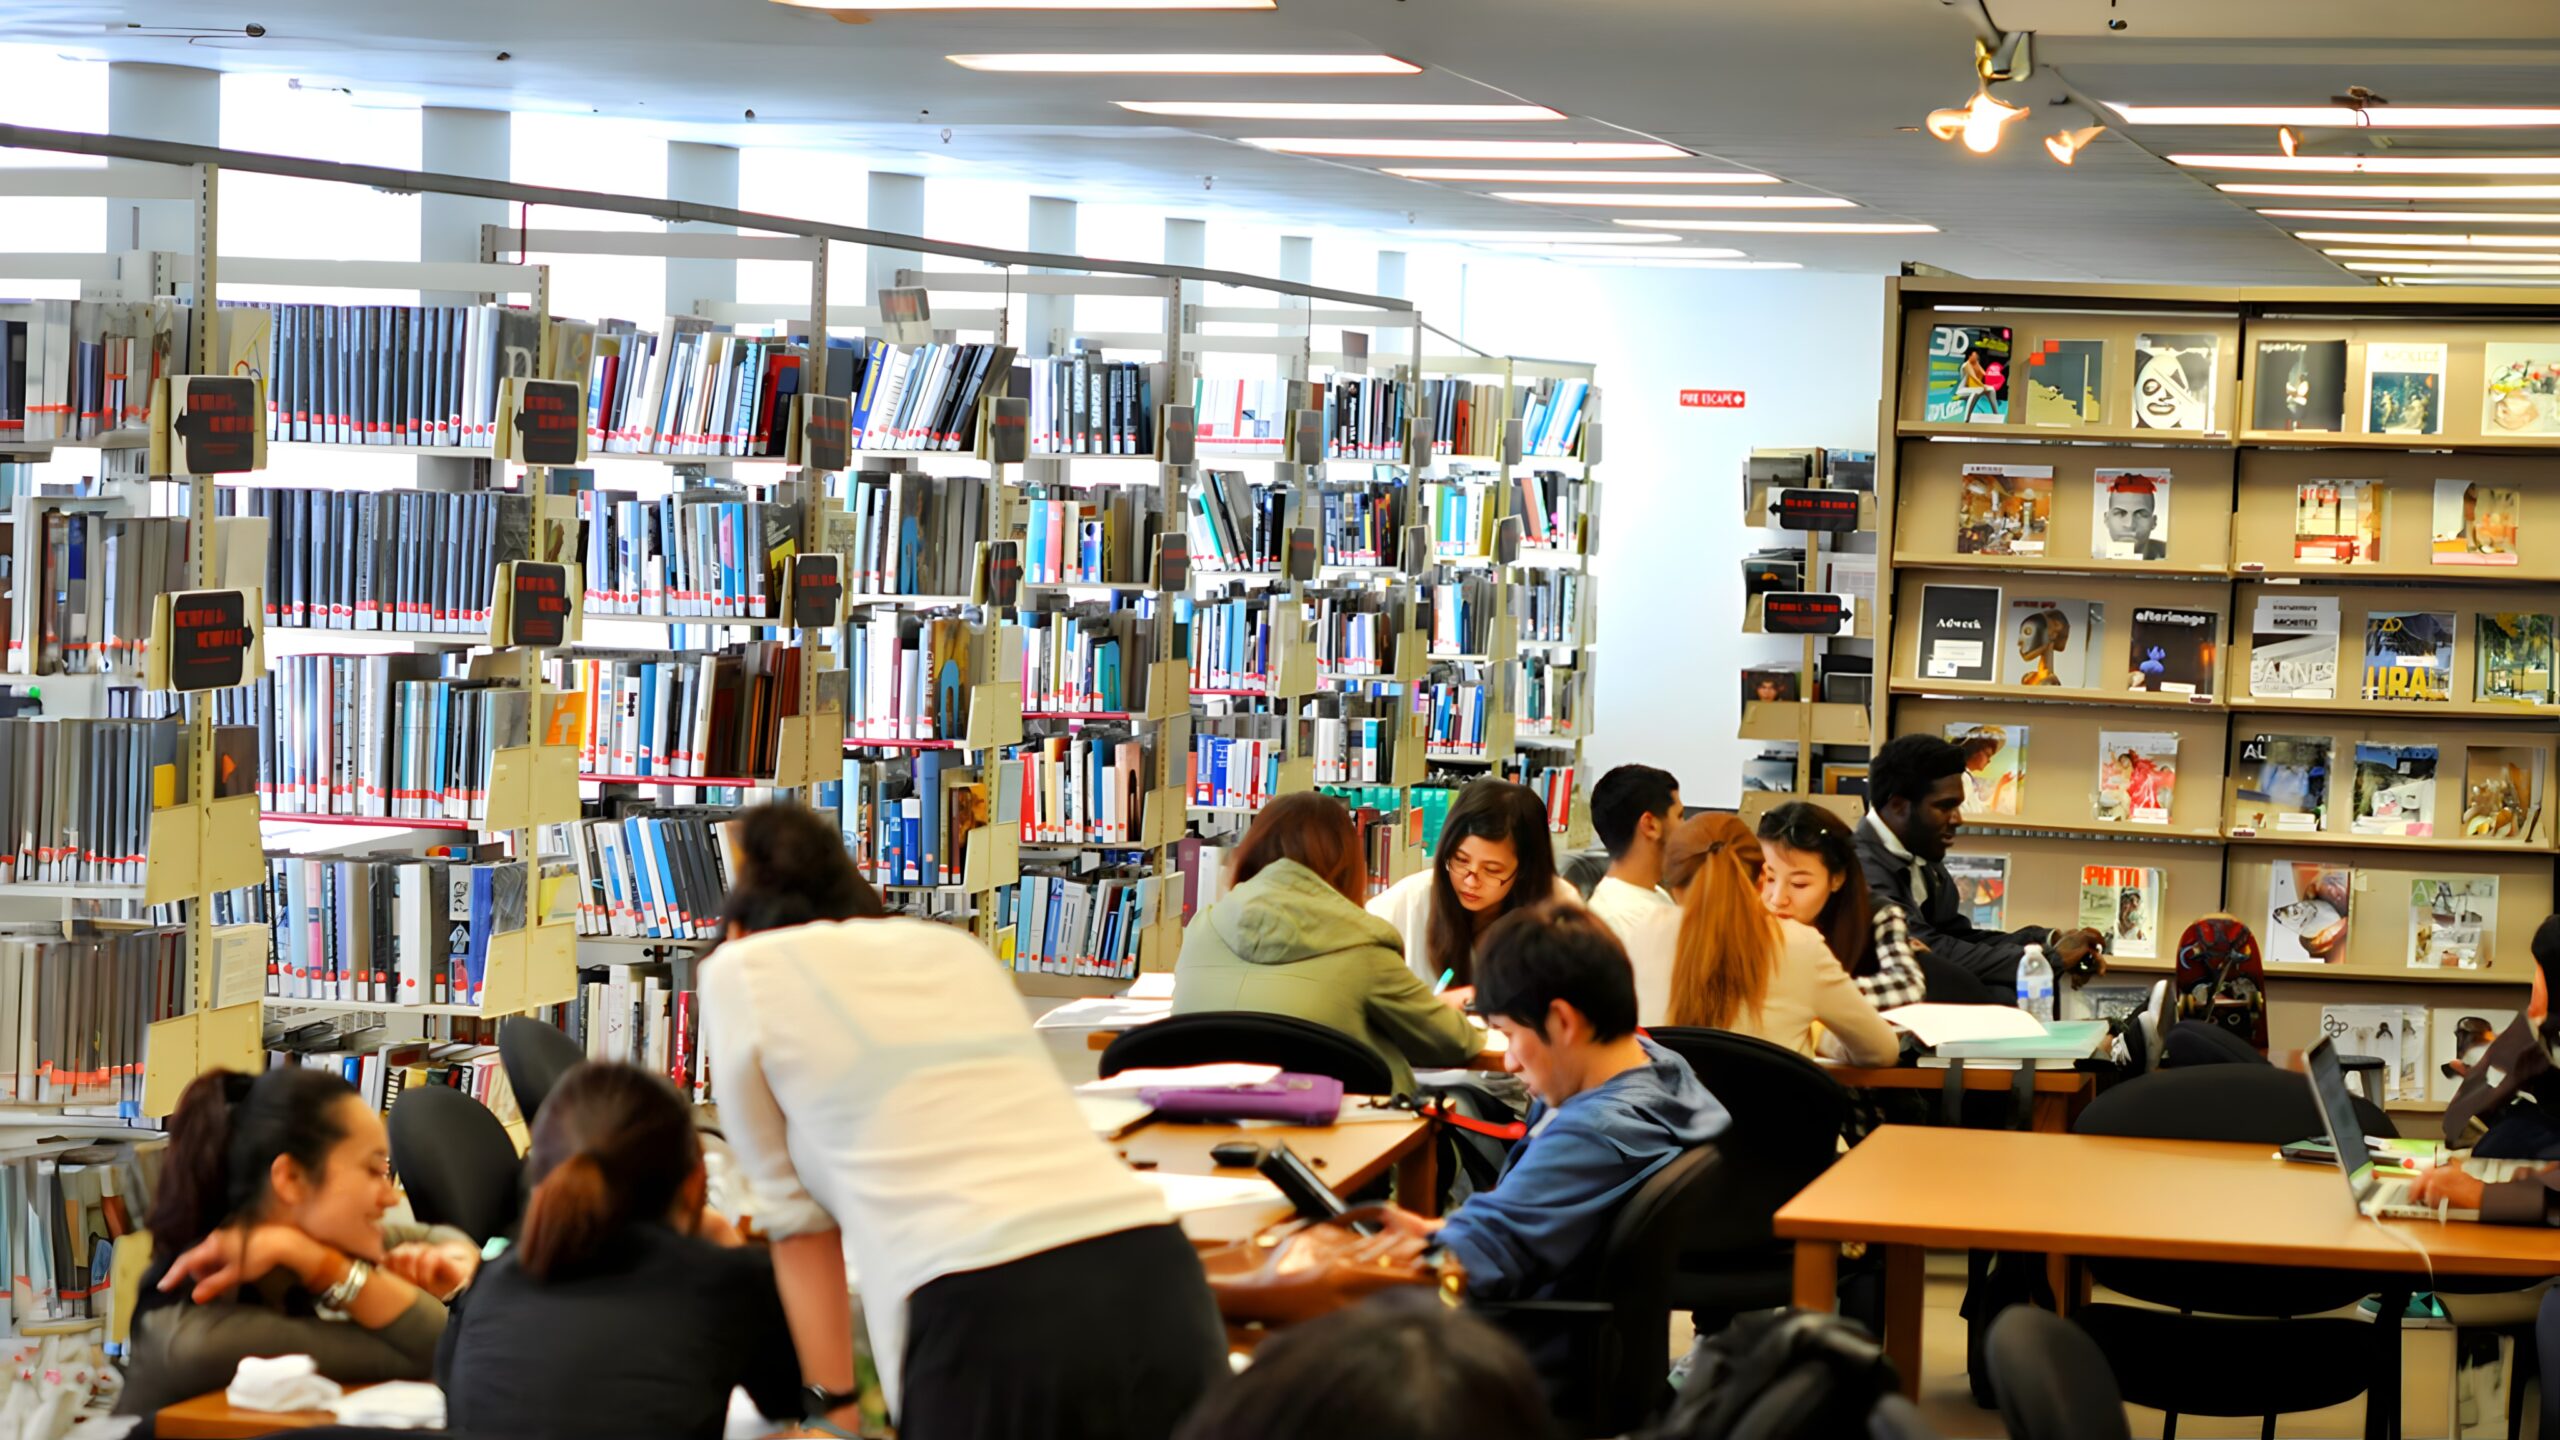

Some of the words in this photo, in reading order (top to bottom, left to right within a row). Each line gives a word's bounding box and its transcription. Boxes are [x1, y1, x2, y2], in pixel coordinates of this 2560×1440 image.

[1929, 326, 1969, 358] 3D
[1682, 393, 1698, 405] FIRE
[1702, 393, 1733, 405] ESCAPE
[1936, 618, 1982, 629] Adweek
[2135, 610, 2206, 627] afterimage
